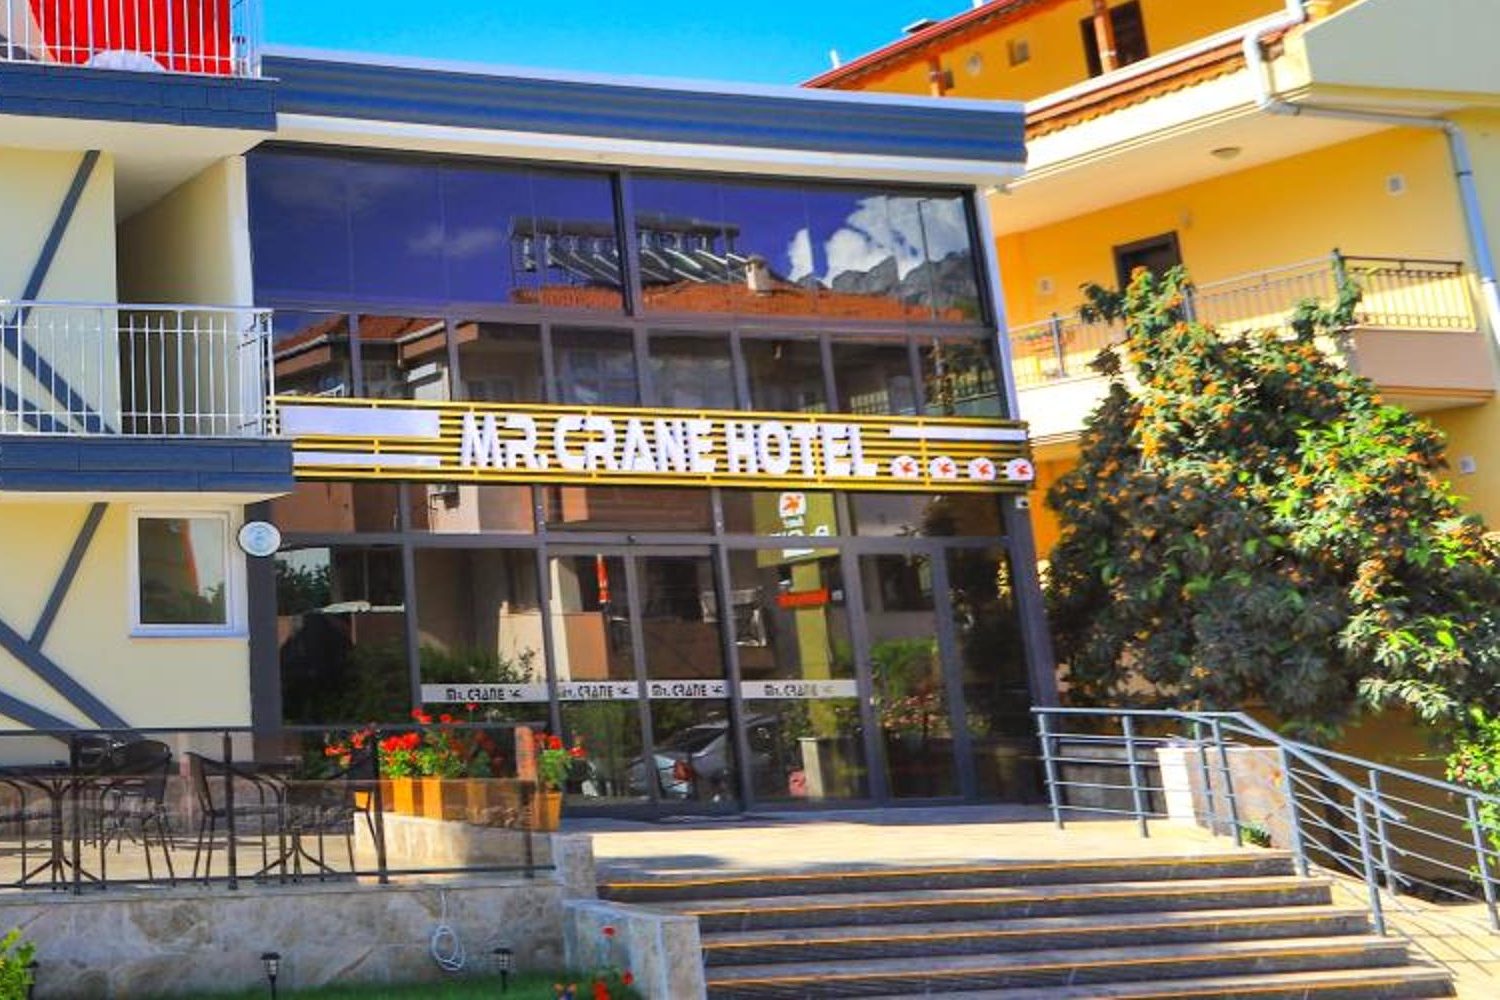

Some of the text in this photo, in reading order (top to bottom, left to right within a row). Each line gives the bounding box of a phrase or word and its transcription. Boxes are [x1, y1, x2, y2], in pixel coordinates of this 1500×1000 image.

[553, 415, 717, 474] CRANE
[724, 420, 879, 478] HOTEL
[467, 688, 506, 701] CRANE
[577, 685, 614, 698] CRANE
[672, 684, 709, 697] CRANE
